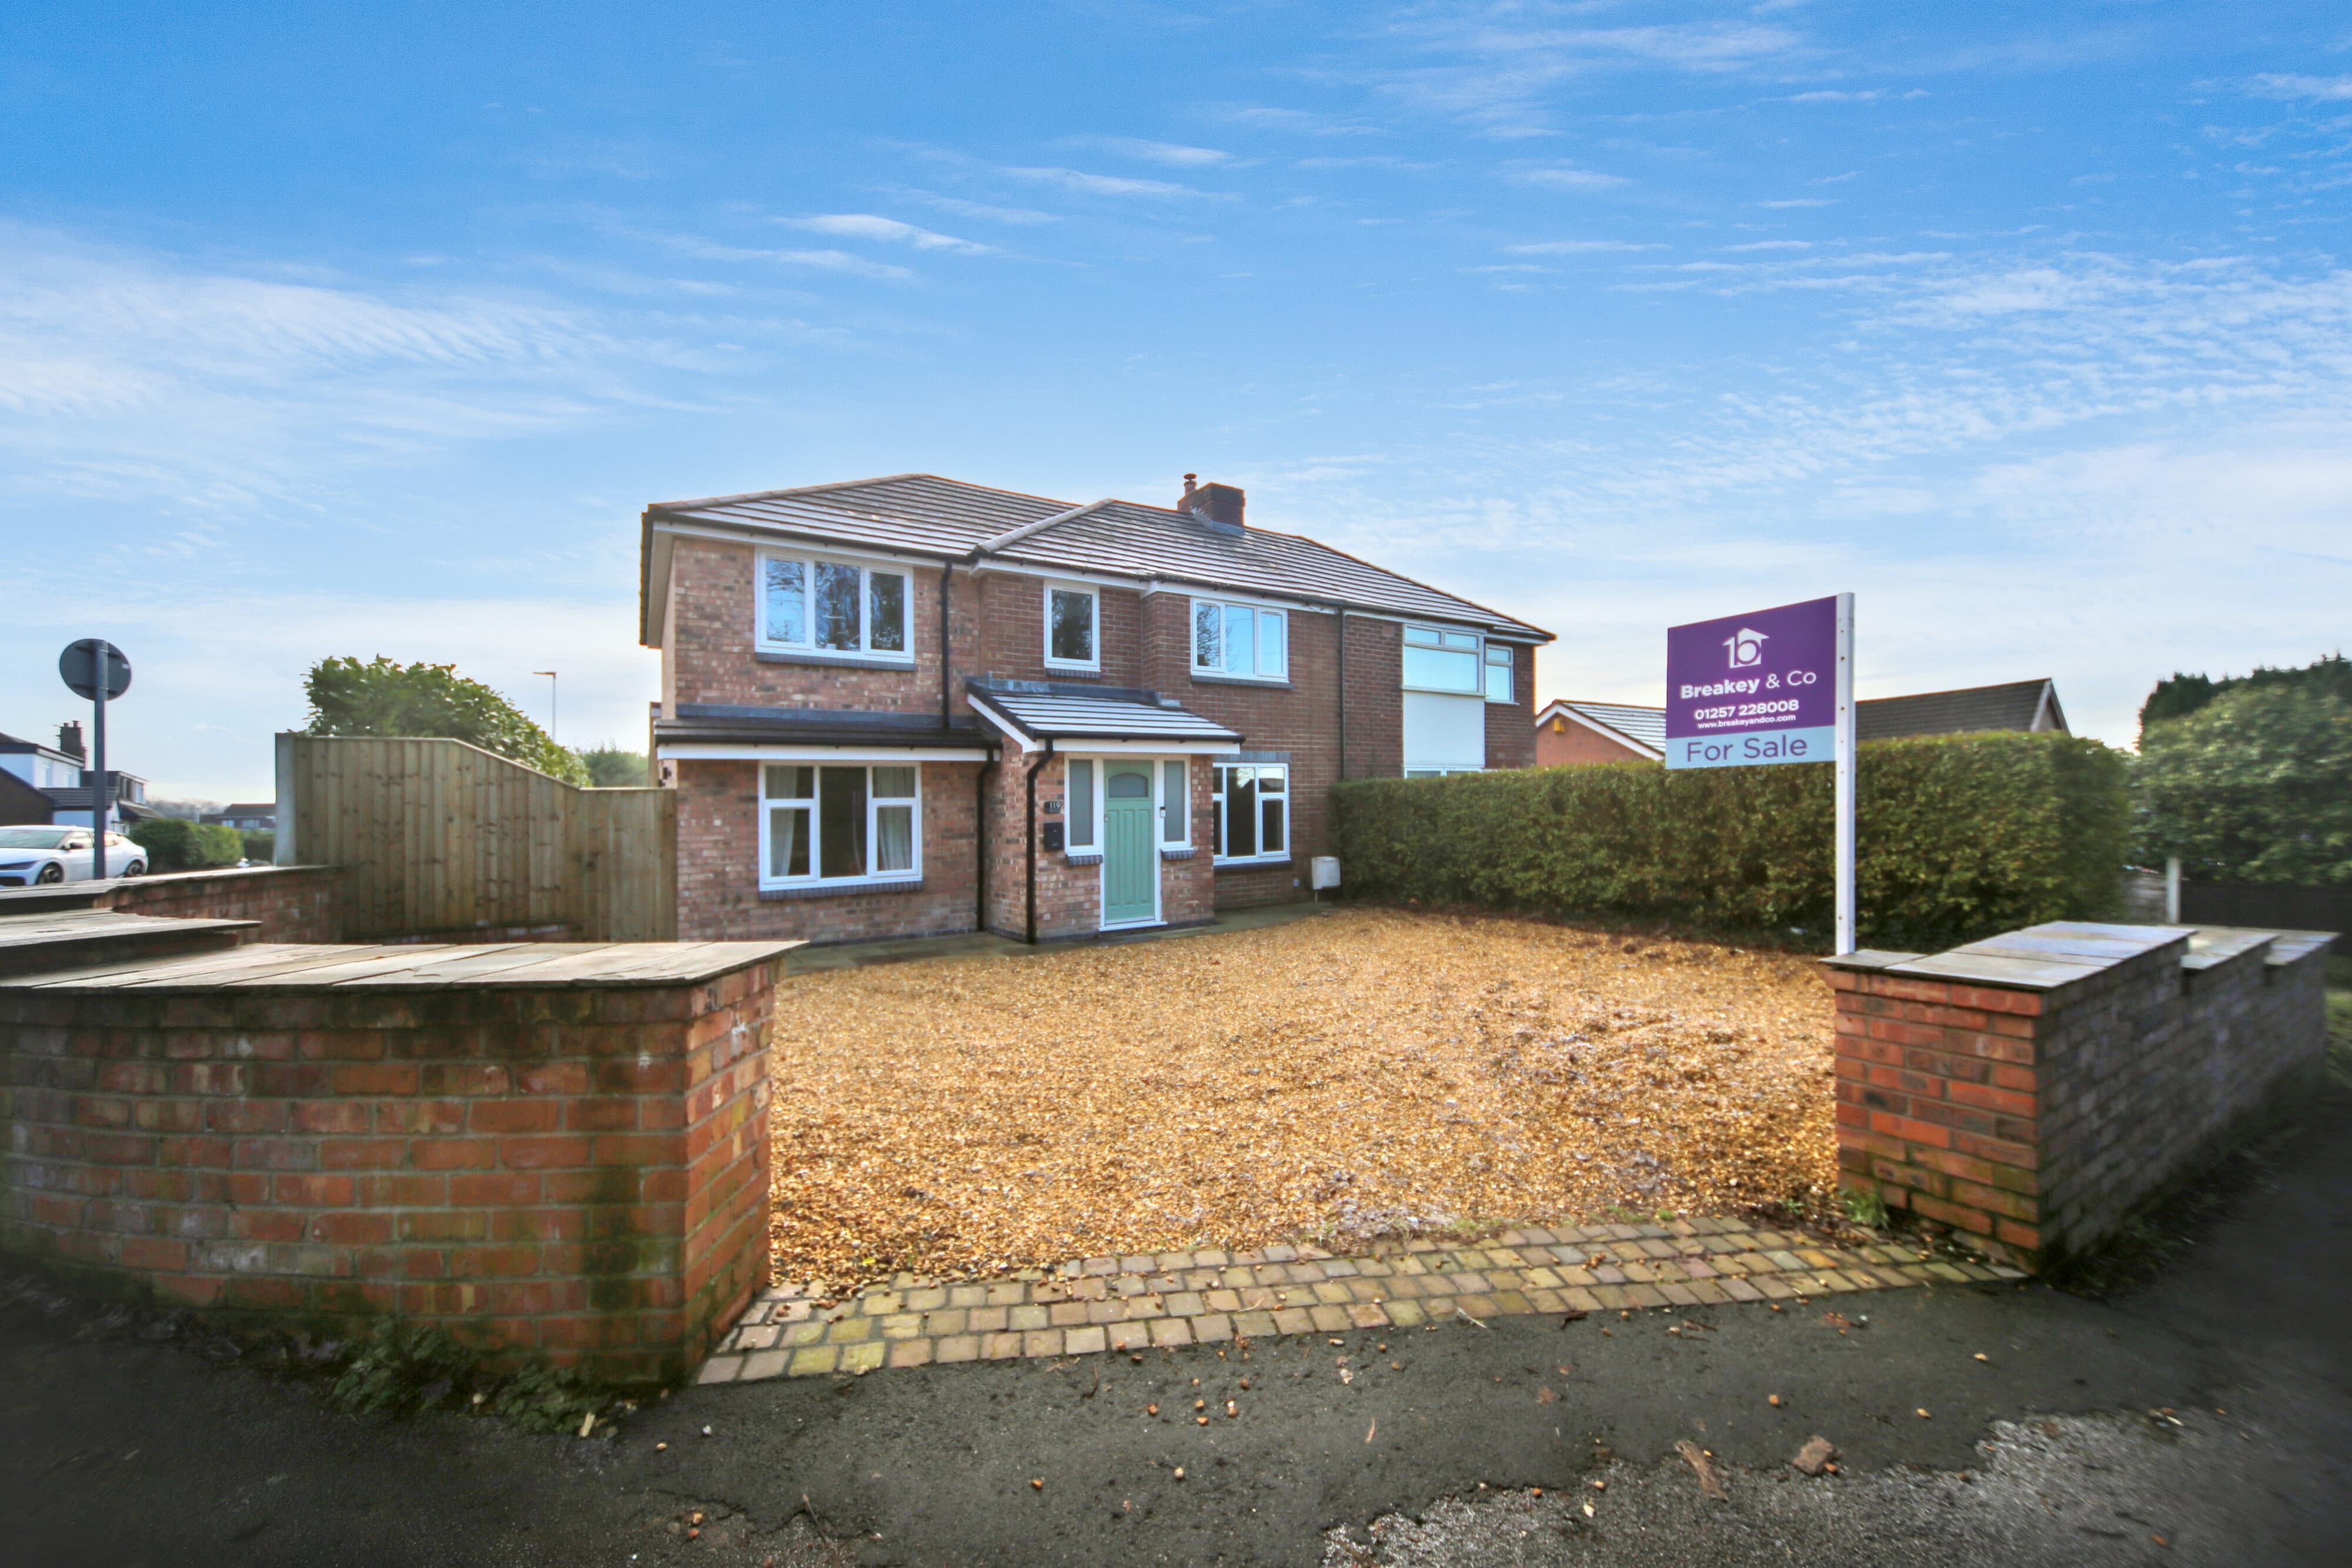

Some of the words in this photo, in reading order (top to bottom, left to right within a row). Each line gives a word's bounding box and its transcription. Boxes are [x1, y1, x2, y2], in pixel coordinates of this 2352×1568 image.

[1681, 678, 1760, 698] Breakey
[1766, 674, 1780, 688] &
[1787, 670, 1816, 686] Co
[1695, 706, 1735, 720] 01257
[1739, 700, 1799, 716] 228008
[1698, 714, 1796, 728] www.breakeyandco.com
[1687, 741, 1733, 762] For
[1743, 735, 1807, 758] Sale
